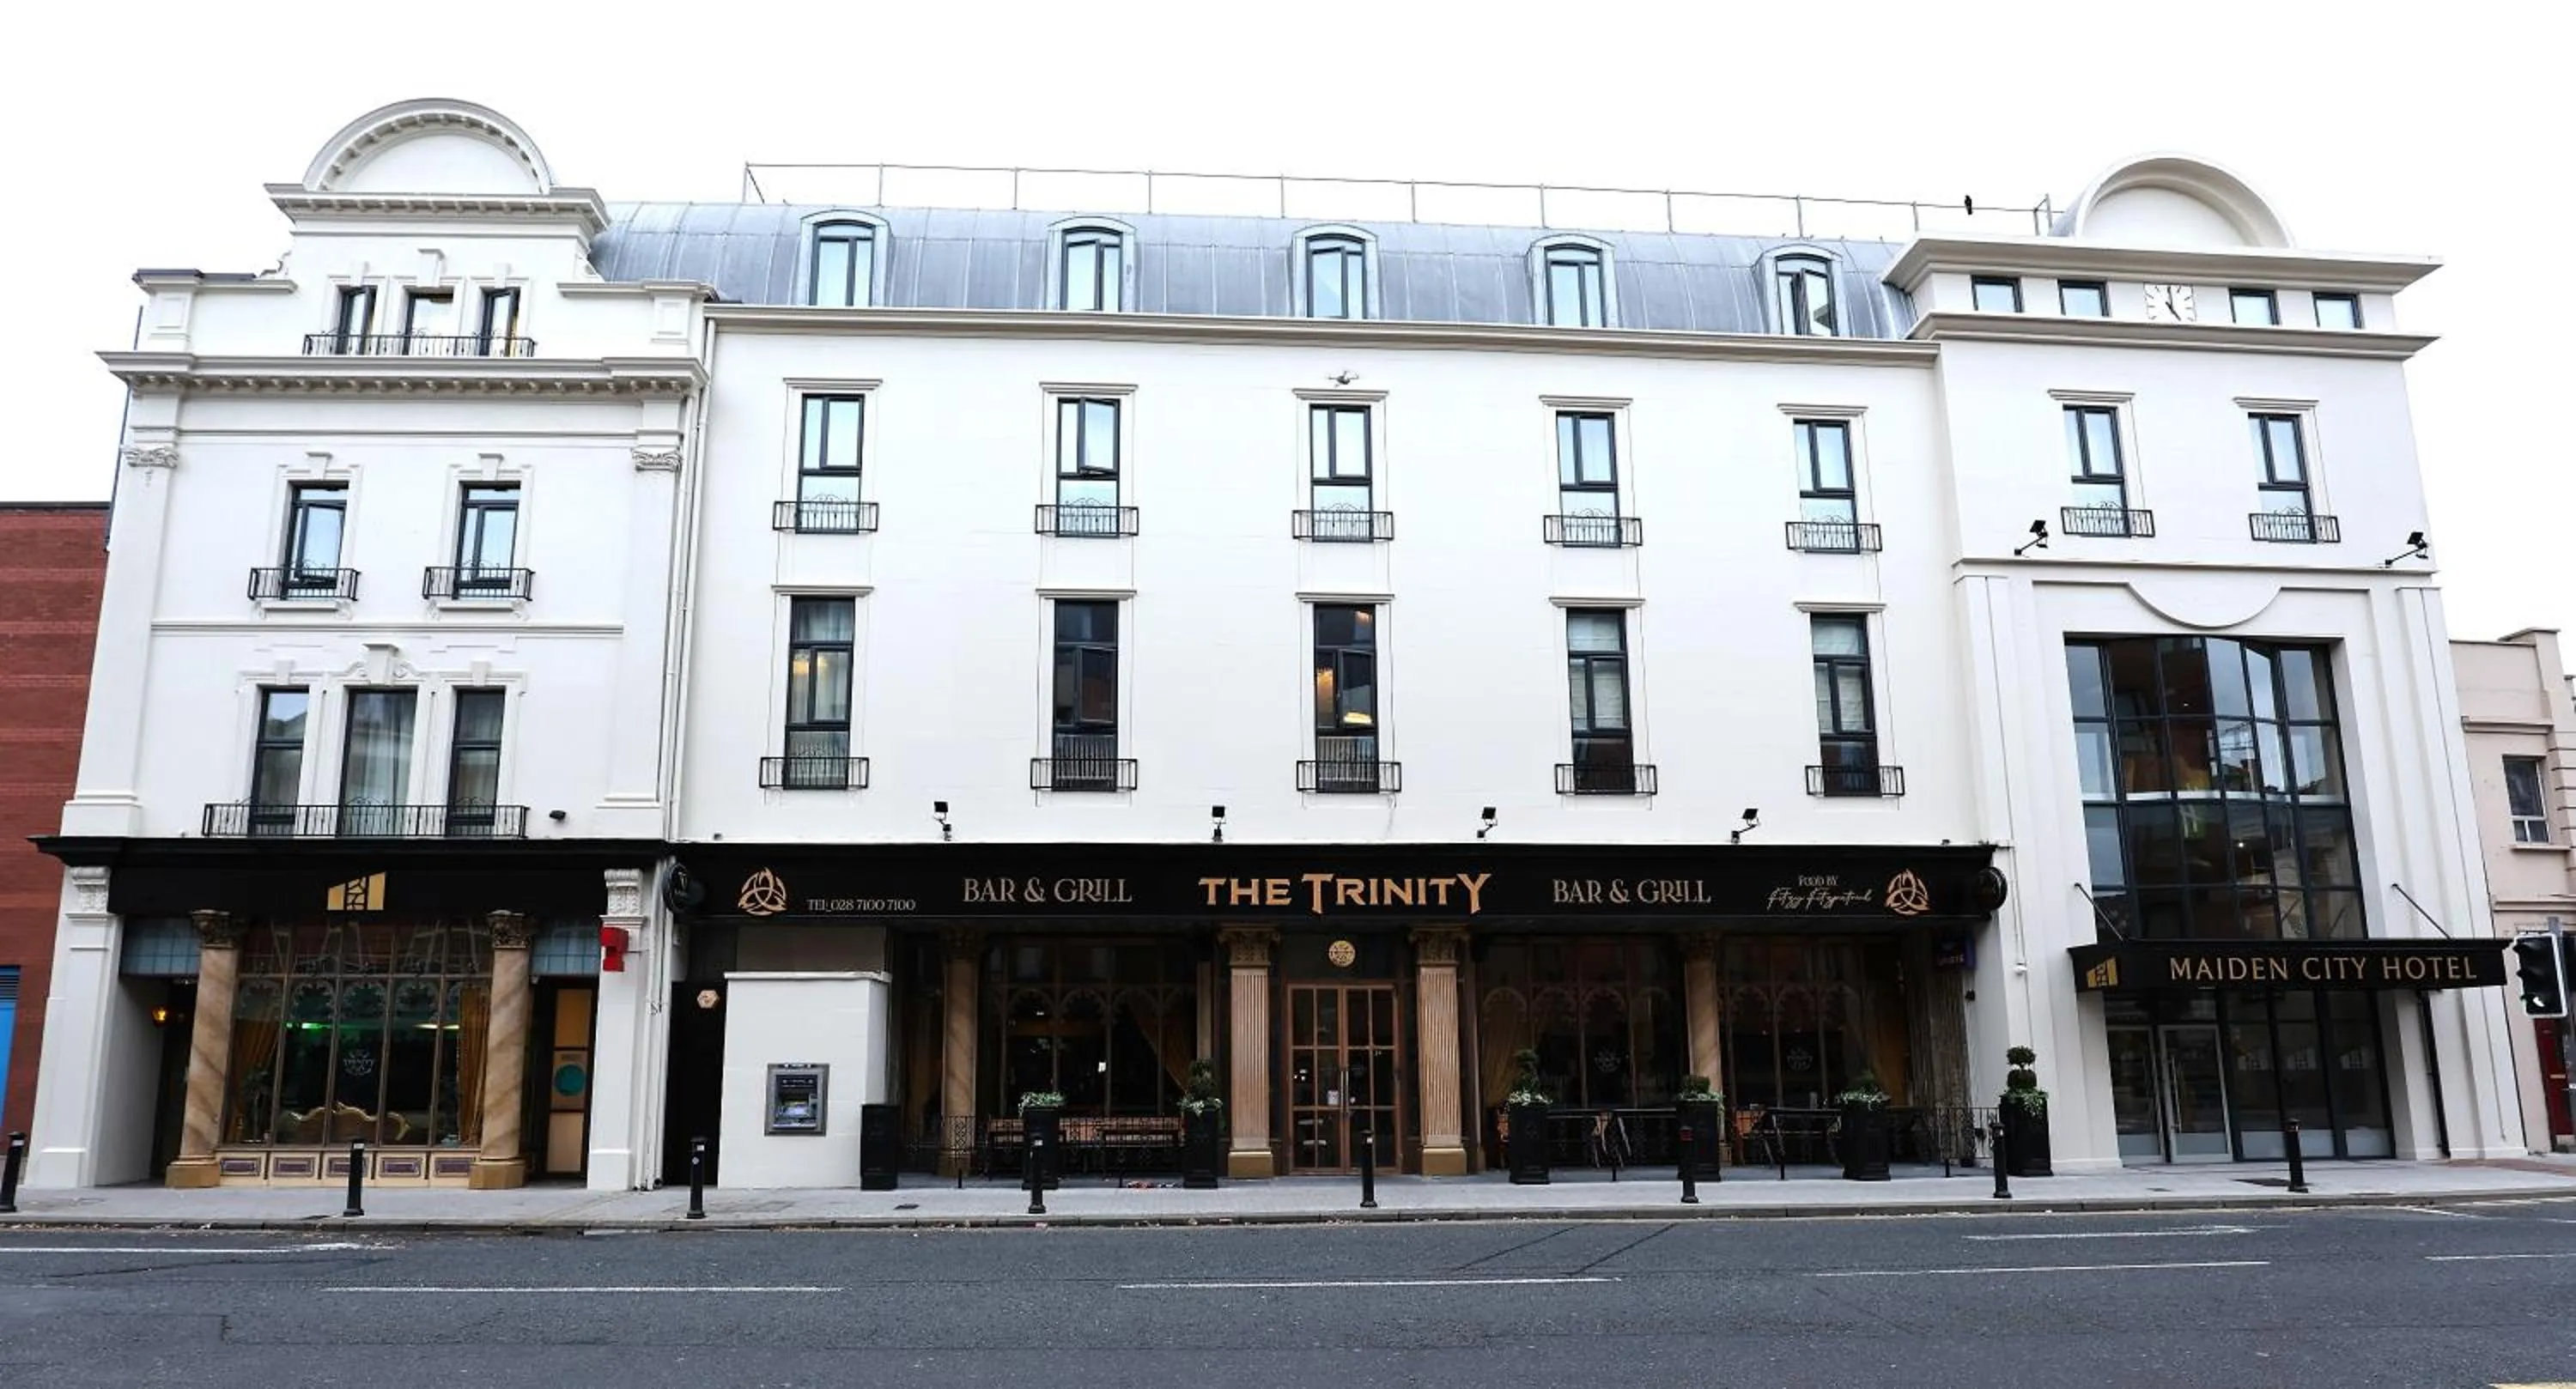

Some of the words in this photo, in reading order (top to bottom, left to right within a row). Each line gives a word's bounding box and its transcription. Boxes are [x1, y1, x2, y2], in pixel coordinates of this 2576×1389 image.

[963, 877, 1016, 902] BAR
[1024, 876, 1046, 902] &
[1054, 878, 1133, 902] GRILL
[1552, 878, 1603, 903] BAR
[1609, 878, 1631, 903] &
[1637, 878, 1711, 903] GRILL
[1799, 875, 1825, 886] FOOD
[1826, 875, 1839, 886] BY
[857, 899, 885, 911] 7100
[887, 899, 916, 911] 7100
[1199, 878, 1292, 905] THE
[1302, 873, 1492, 914] TRINITY
[2170, 956, 2288, 980] MAIDEN
[2302, 956, 2366, 980] CITY
[2383, 956, 2477, 980] HOTEL
